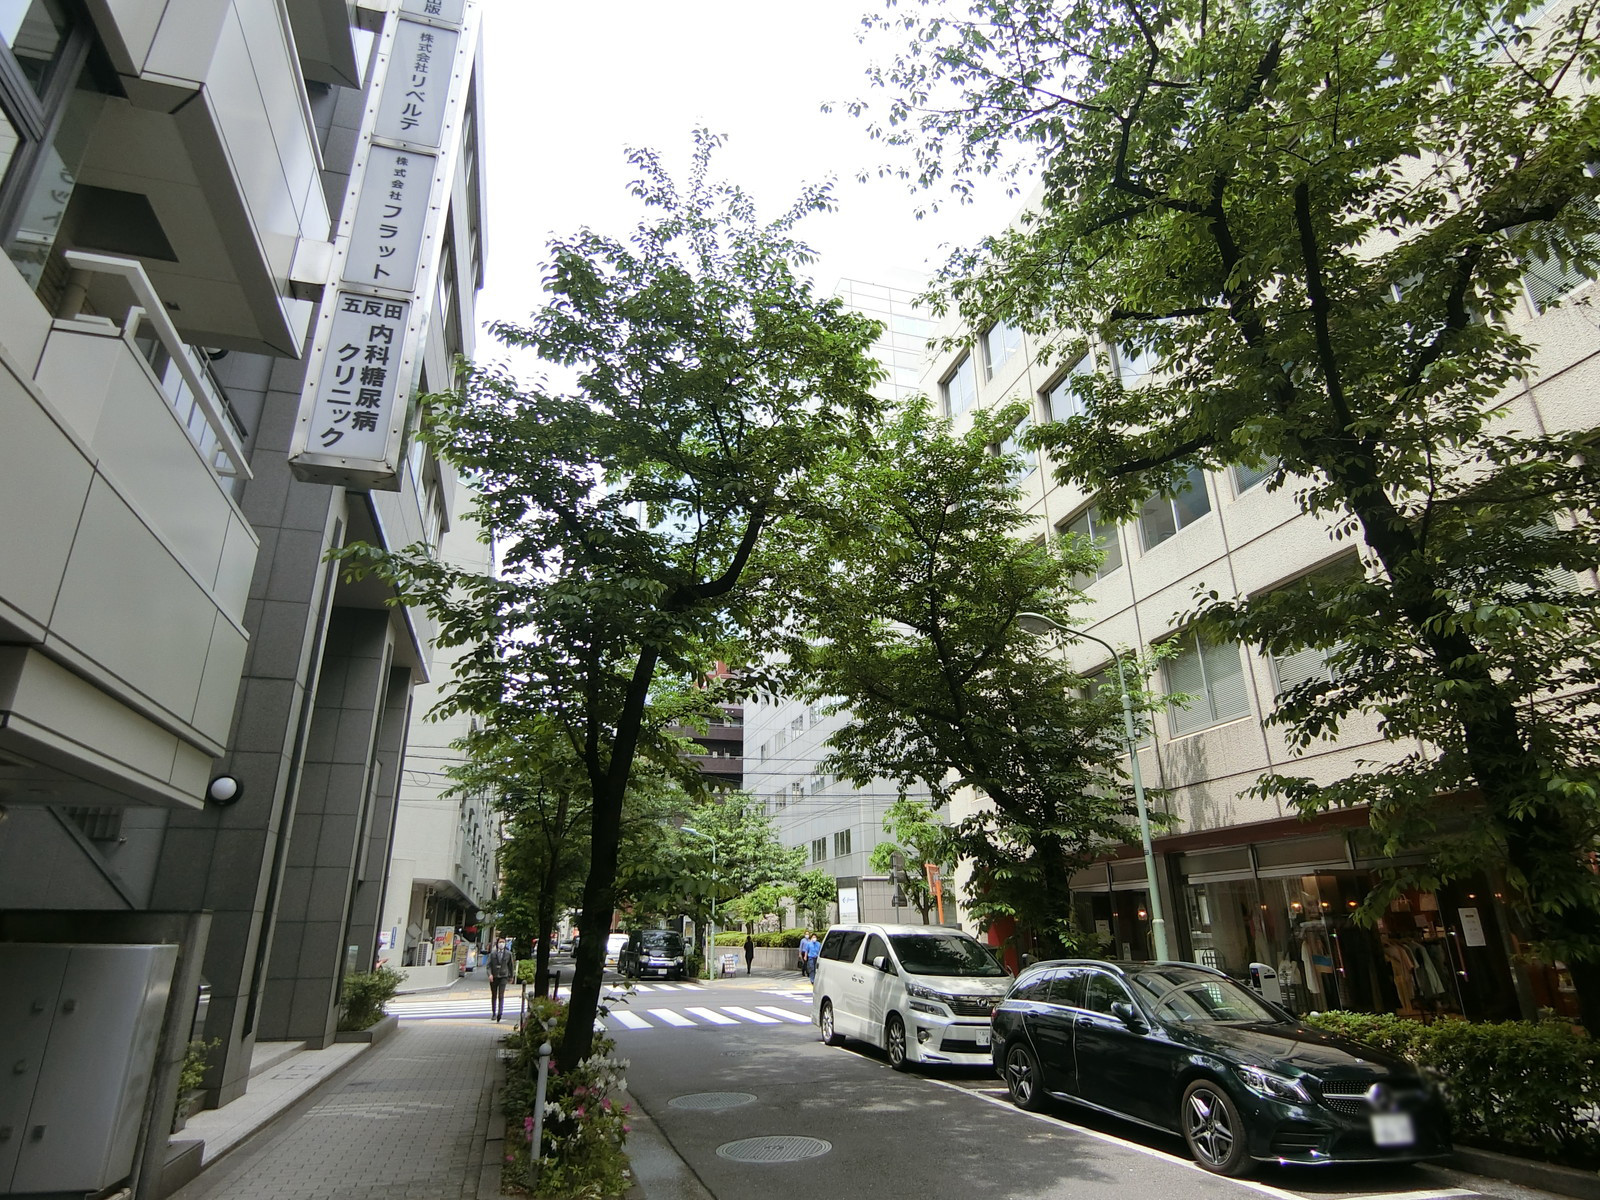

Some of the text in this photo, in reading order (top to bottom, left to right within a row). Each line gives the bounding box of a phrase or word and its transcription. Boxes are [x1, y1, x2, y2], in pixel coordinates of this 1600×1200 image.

[400, 32, 434, 130] 株式会社リベルテ
[373, 156, 408, 279] 株式会社フラット
[341, 297, 402, 320] 五反田
[320, 343, 360, 448] クリニック
[352, 324, 394, 432] 内科糖尿病
